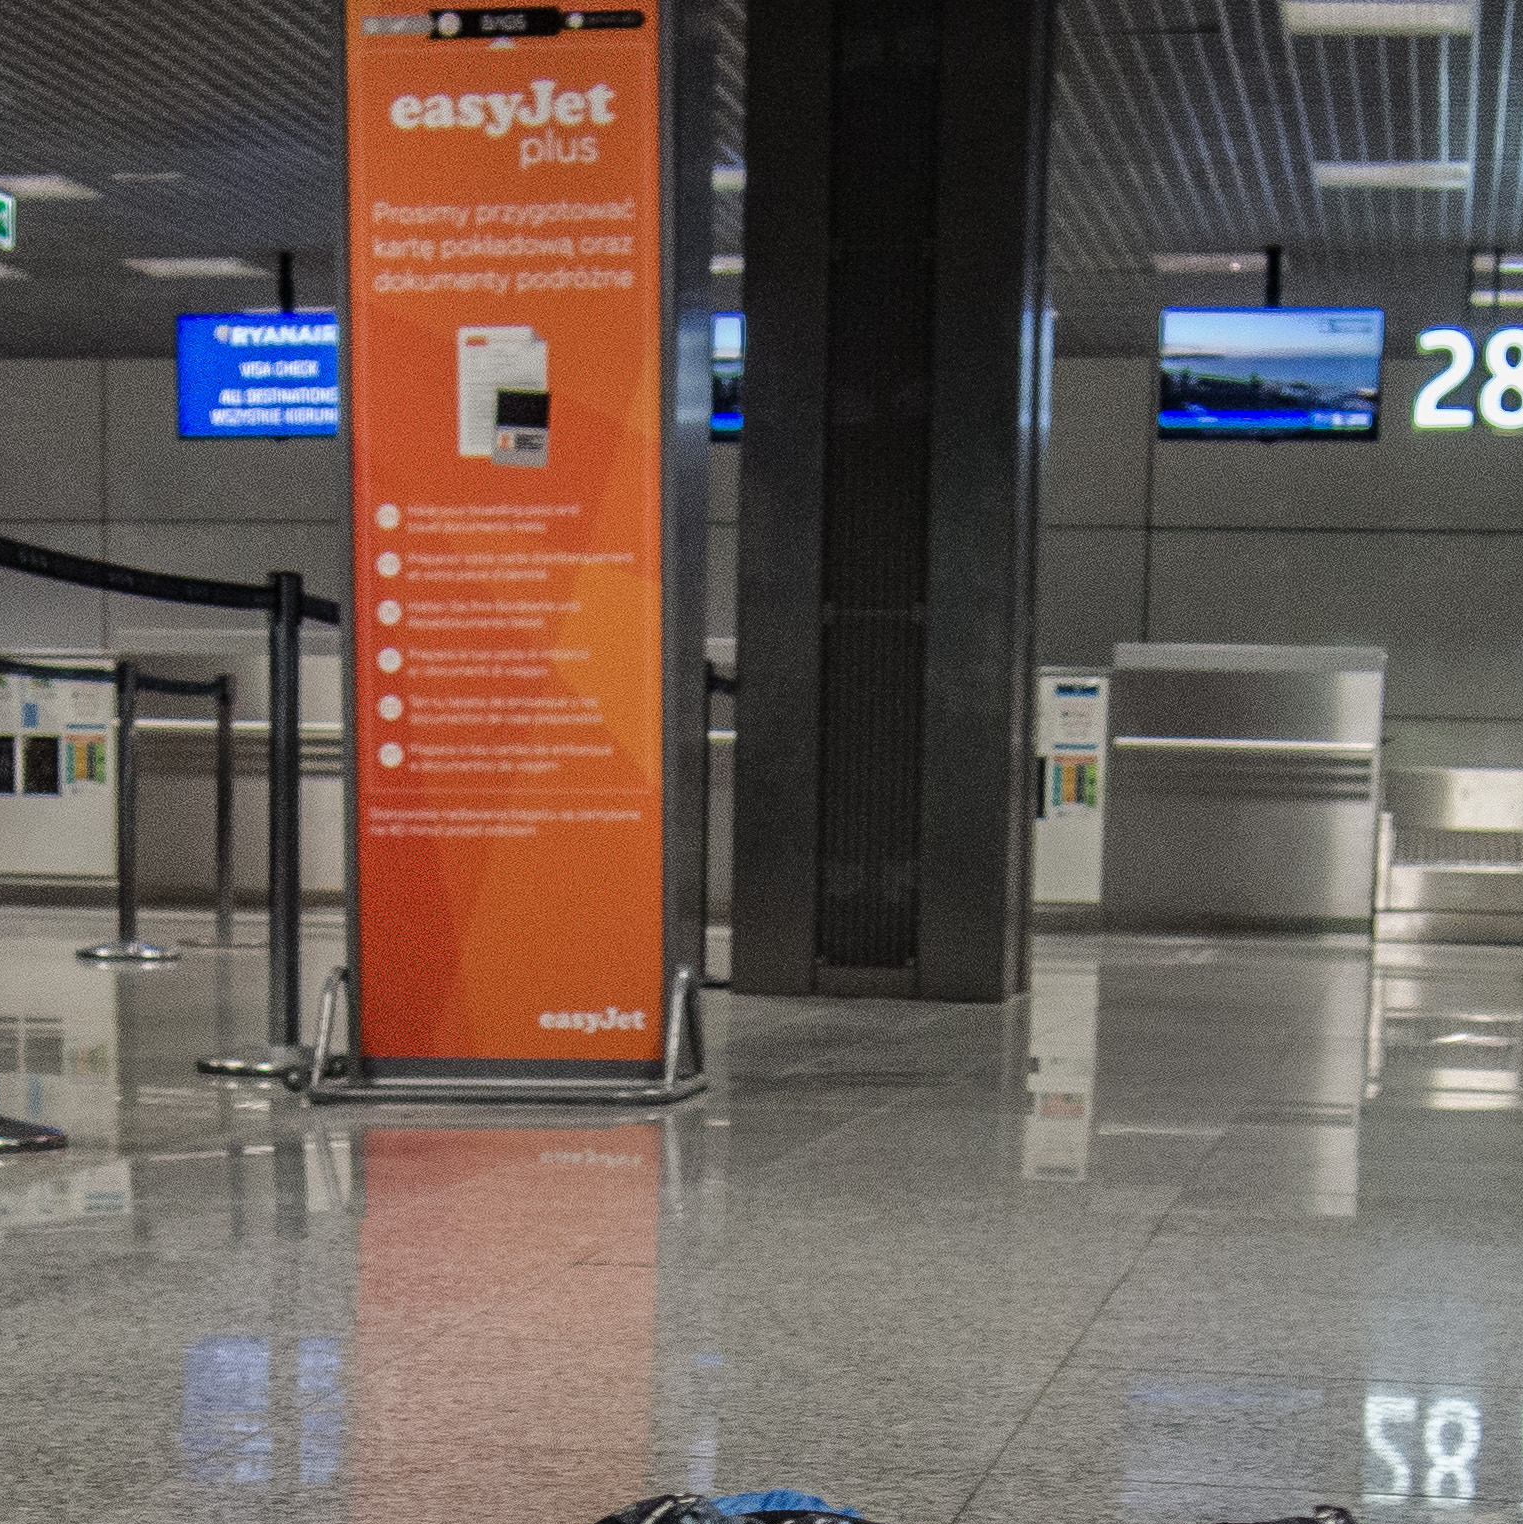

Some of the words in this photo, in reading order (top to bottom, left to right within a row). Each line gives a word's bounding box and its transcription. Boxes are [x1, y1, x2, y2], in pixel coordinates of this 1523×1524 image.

[389, 79, 616, 138] easyJet
[519, 131, 599, 169] plus
[372, 201, 469, 228] Prosimy
[475, 197, 636, 226] przygotować
[372, 236, 434, 261] kartę
[578, 235, 634, 256] oraz
[372, 269, 510, 295] dokumenty
[515, 266, 634, 293] podróżne
[538, 1005, 647, 1034] easyJet
